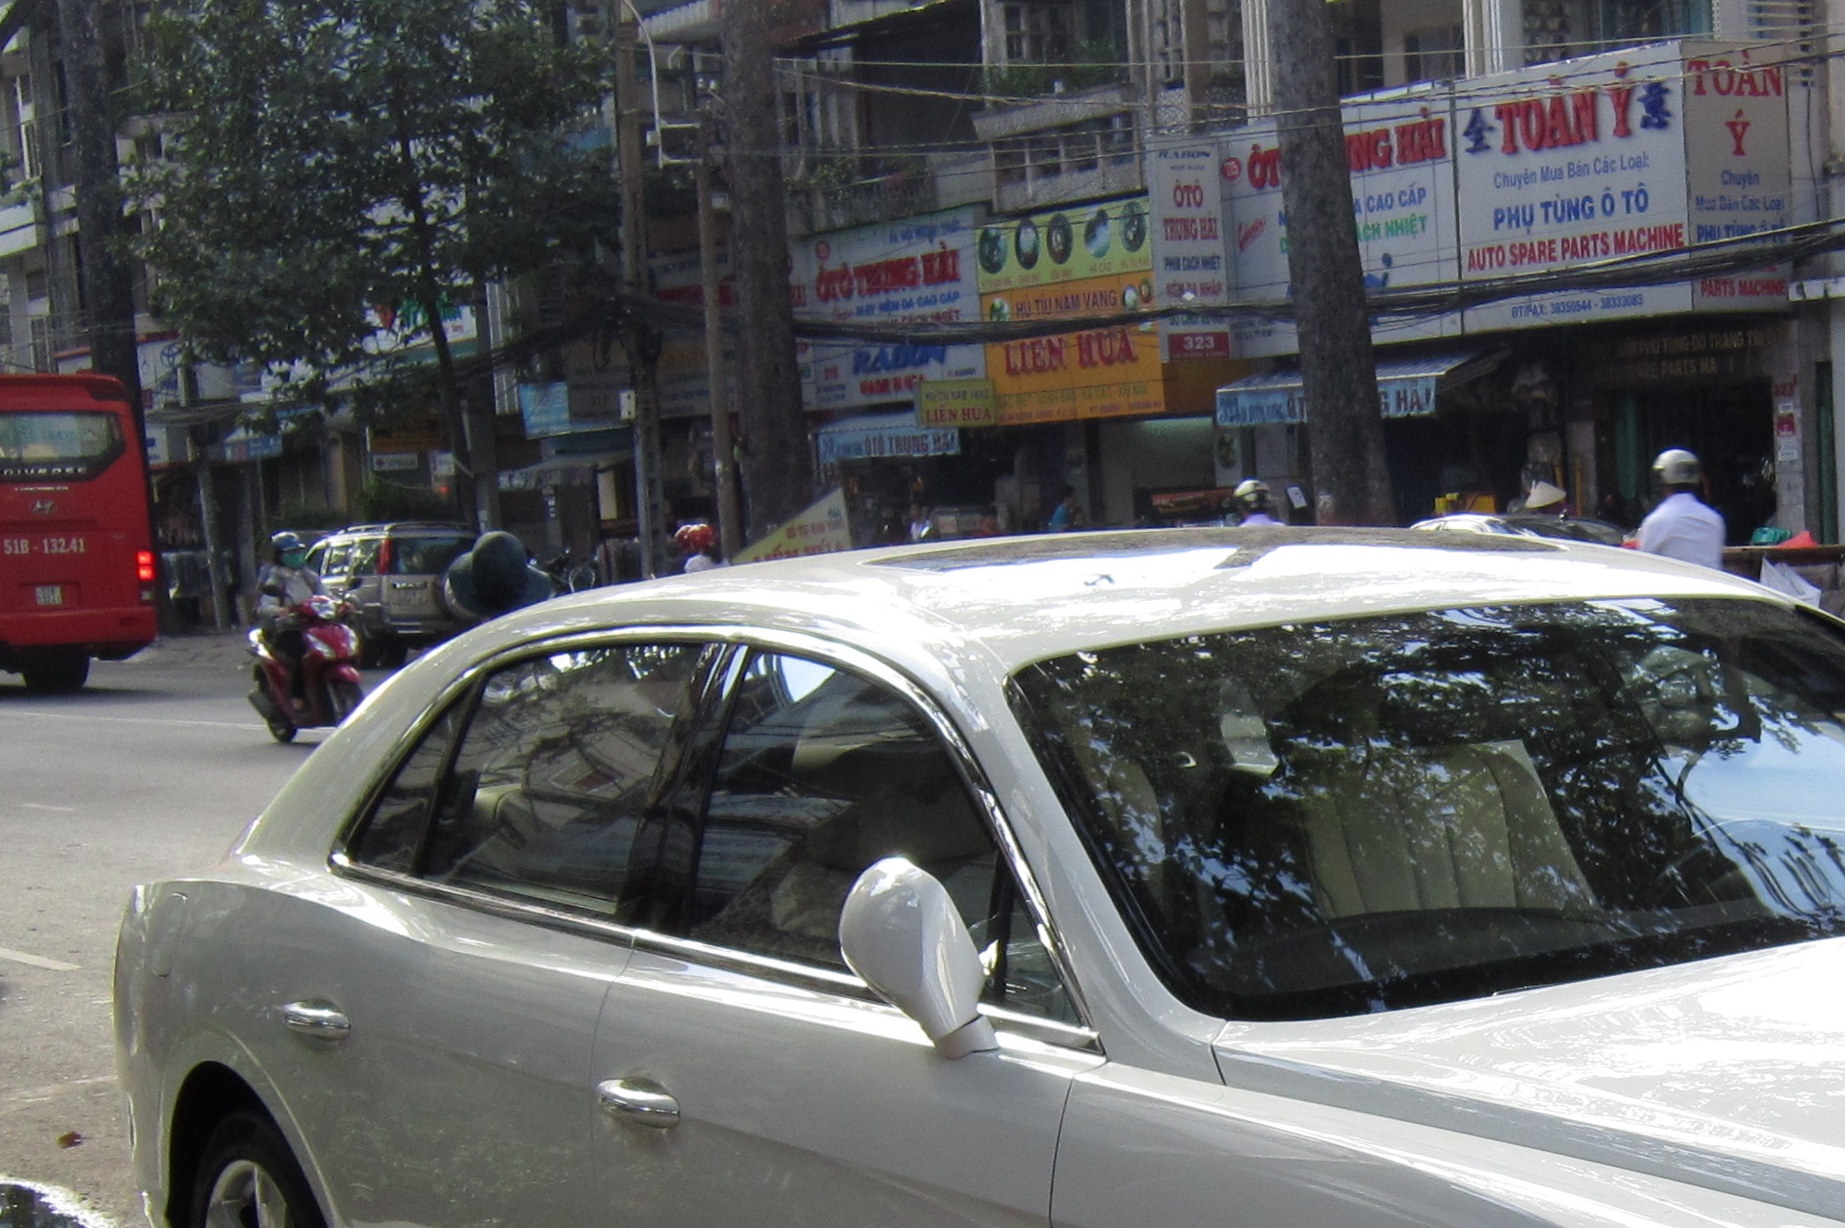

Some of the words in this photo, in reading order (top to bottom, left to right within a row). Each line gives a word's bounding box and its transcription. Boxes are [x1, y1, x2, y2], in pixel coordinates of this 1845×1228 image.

[1541, 166, 1563, 182] Mua
[1367, 193, 1393, 213] CAO
[1493, 203, 1534, 234] PHỤ
[1541, 194, 1595, 224] TÙNG
[1468, 245, 1505, 272] AUTO
[1509, 239, 1558, 266] SPARE
[1561, 232, 1609, 261] PARTS
[1614, 223, 1685, 254] MACHINE
[1701, 279, 1735, 298] PARTS
[1739, 277, 1786, 297] MACHINE
[1183, 335, 1215, 350] 323
[4, 538, 29, 555] 51B
[43, 537, 86, 554] 132.41
